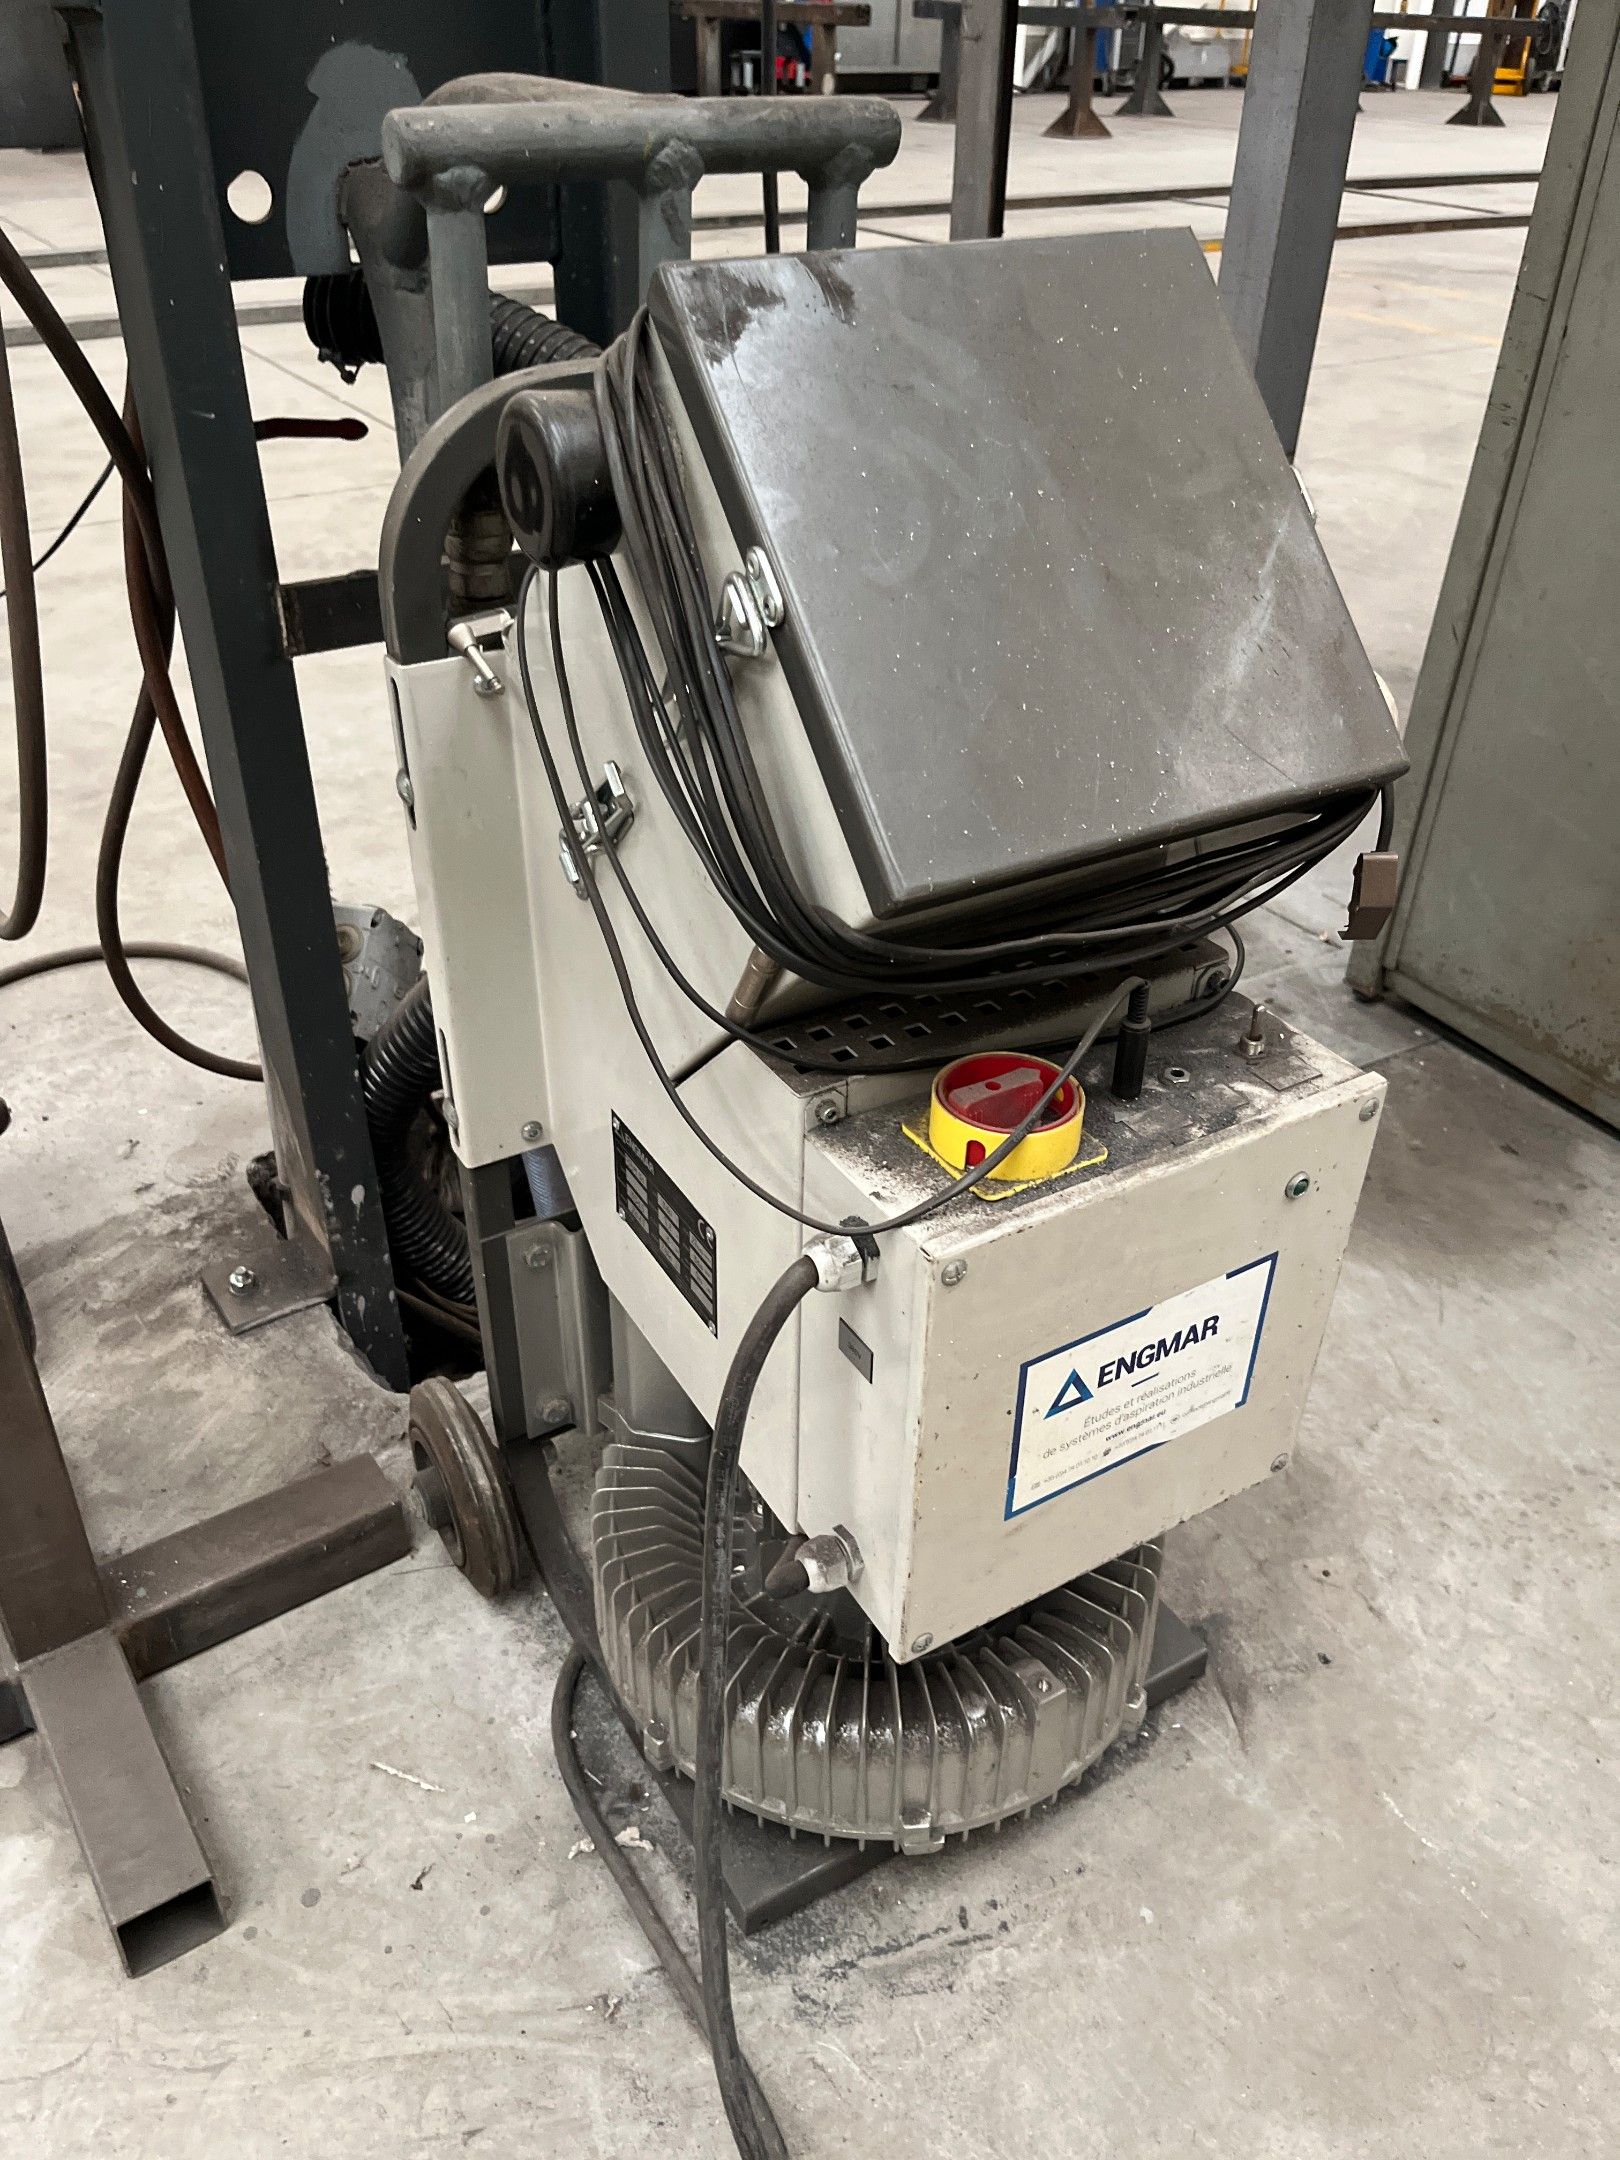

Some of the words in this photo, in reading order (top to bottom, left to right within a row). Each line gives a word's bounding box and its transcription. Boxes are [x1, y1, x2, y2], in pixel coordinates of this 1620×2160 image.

[1097, 1315, 1220, 1389] ENGMAR
[1042, 1447, 1057, 1460] de
[1059, 1421, 1112, 1453] systèmes
[1114, 1391, 1174, 1426] d'aspiration
[1177, 1363, 1233, 1396] industrielle
[1084, 1404, 1121, 1428] Études
[1123, 1397, 1135, 1409] et
[1136, 1369, 1197, 1403] réalisations
